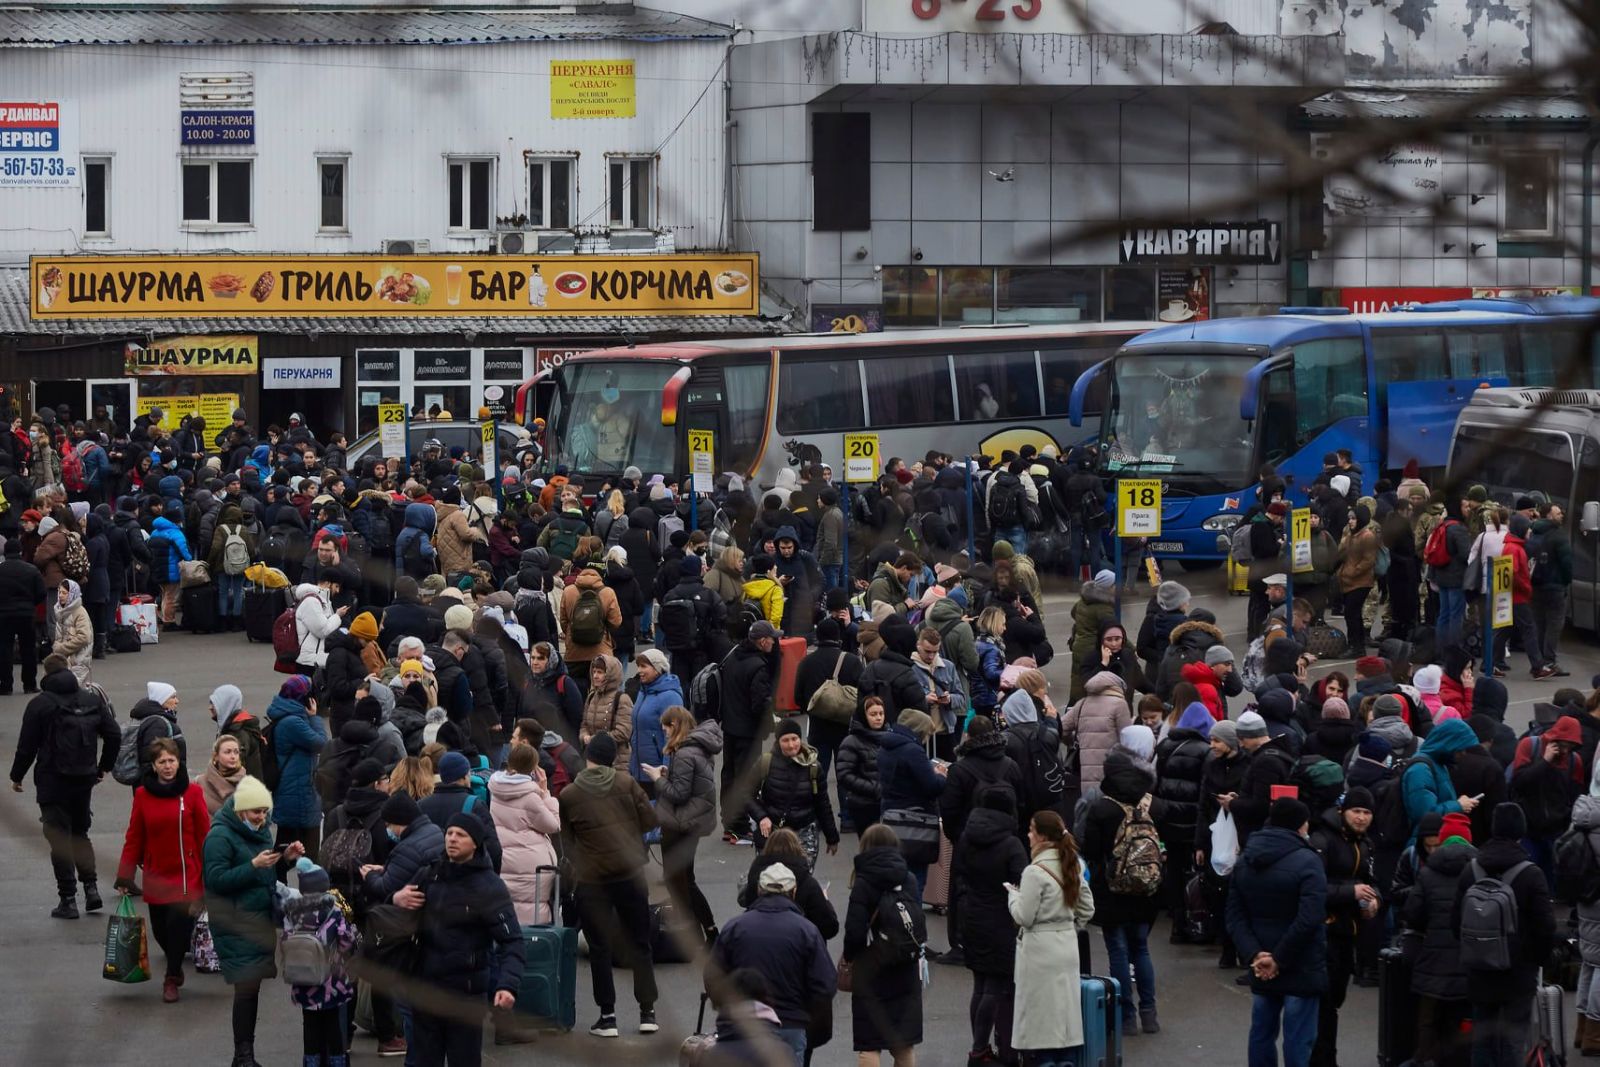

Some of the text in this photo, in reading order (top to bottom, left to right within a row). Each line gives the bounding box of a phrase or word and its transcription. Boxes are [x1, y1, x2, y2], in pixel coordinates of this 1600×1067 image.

[552, 65, 633, 77] ПЕРУКАРНЯ
[182, 115, 253, 126] САЛОН-КРАСИ
[0, 131, 52, 148] ЕРВІС
[186, 129, 214, 140] 10.00
[222, 129, 250, 140] 20.00
[1136, 229, 1266, 255] КАВ'ЯРНЯ
[68, 269, 714, 303] ШАУРМА ГРИЛЬ БАР КОРЧМА
[138, 347, 253, 365] ШАУРМА
[273, 368, 333, 380] ПЕРУКАРНЯ
[383, 409, 405, 423] 23
[484, 427, 494, 441] 22
[693, 436, 708, 451] 21
[850, 441, 874, 457] 20
[1127, 488, 1155, 507] 18
[1131, 512, 1149, 520] Прага
[1295, 518, 1308, 539] 17
[1497, 566, 1510, 590] 16
